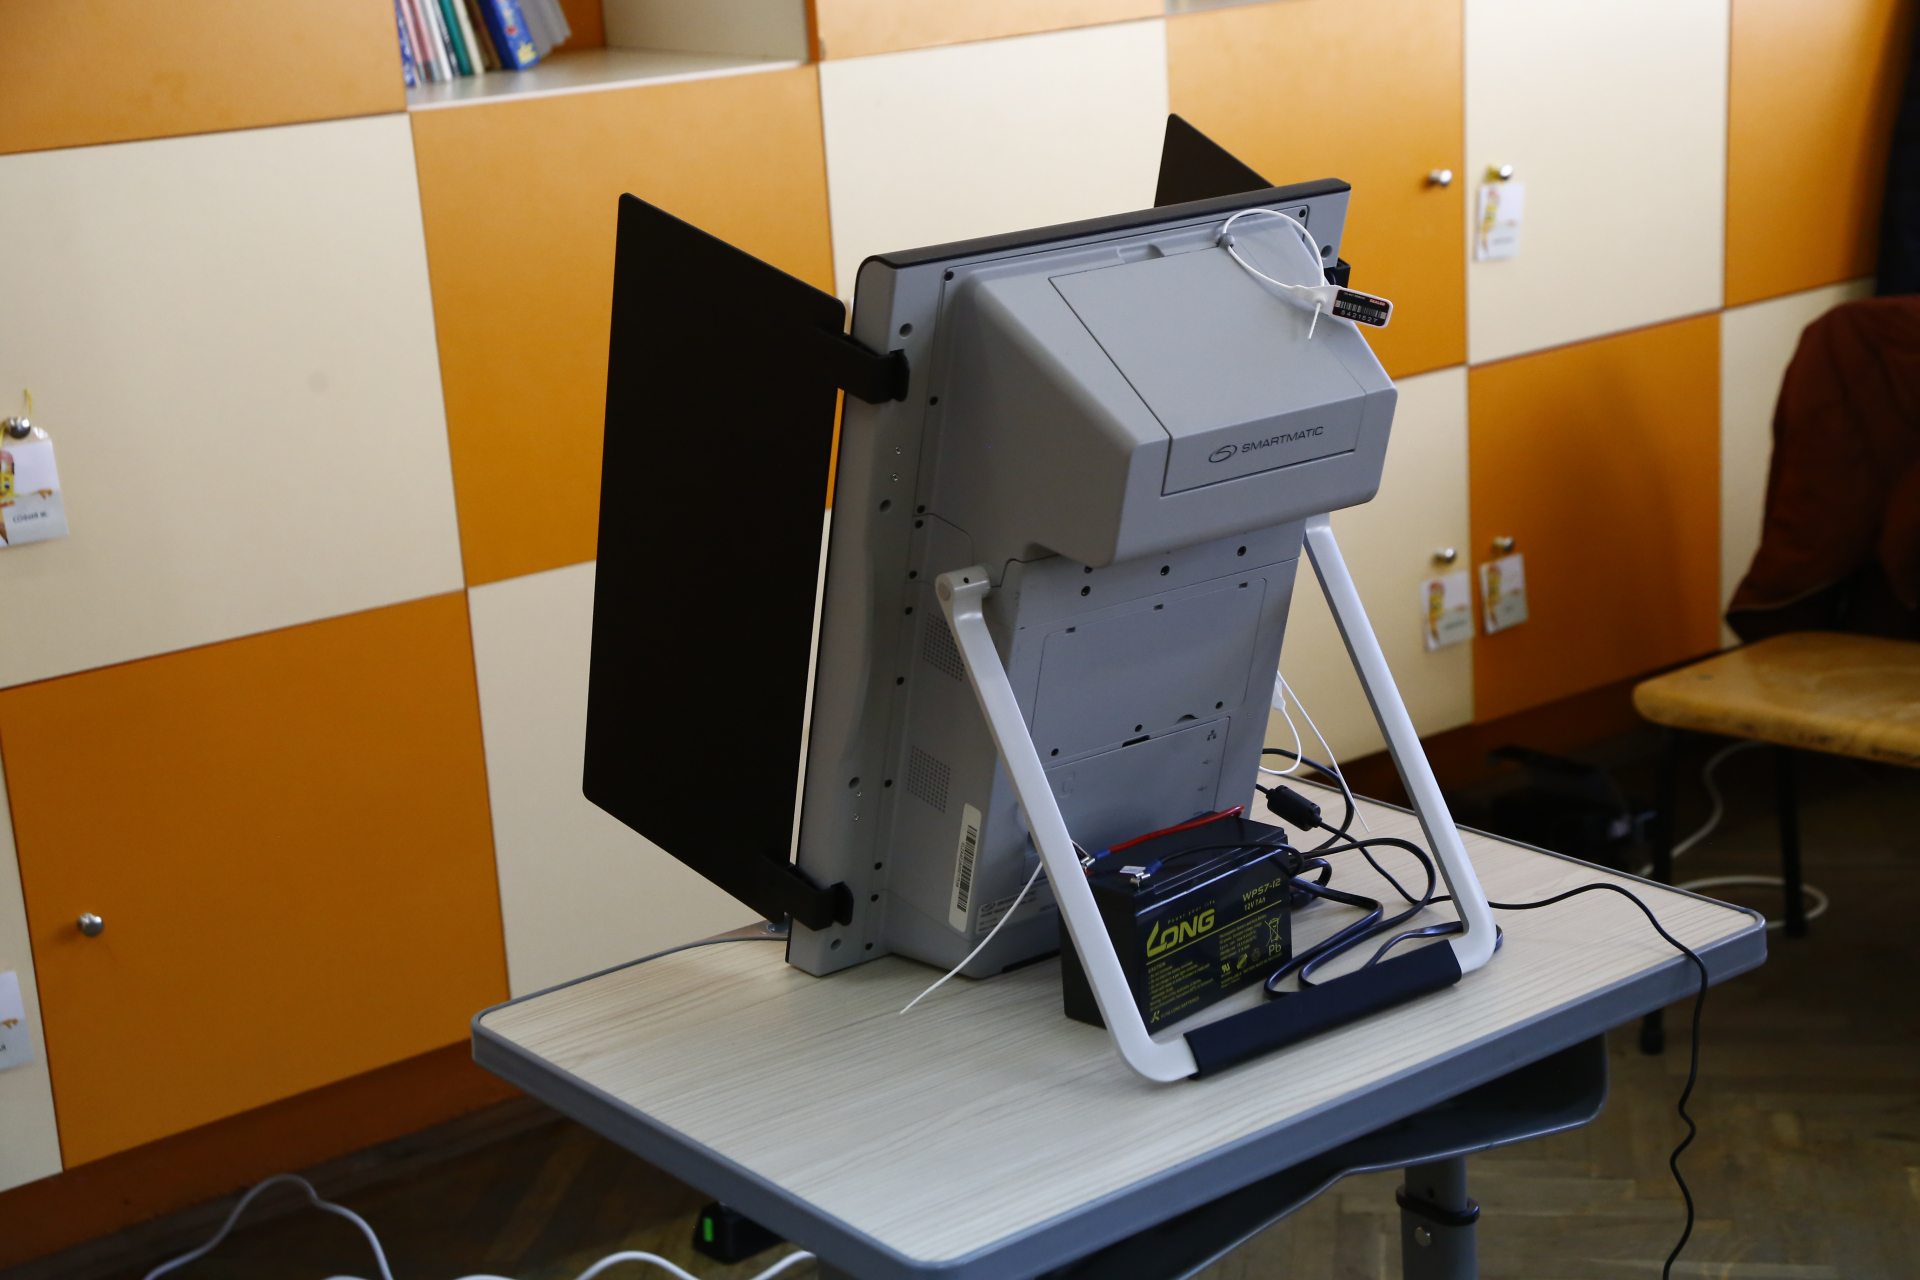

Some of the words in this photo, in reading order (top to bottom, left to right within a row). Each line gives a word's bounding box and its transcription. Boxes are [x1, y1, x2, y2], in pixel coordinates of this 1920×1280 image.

[1241, 426, 1324, 453] SMARTMATIC
[1242, 877, 1281, 902] WPS7-12
[1244, 900, 1255, 911] 12V
[1146, 908, 1215, 958] LONG
[1268, 943, 1282, 956] Pb
